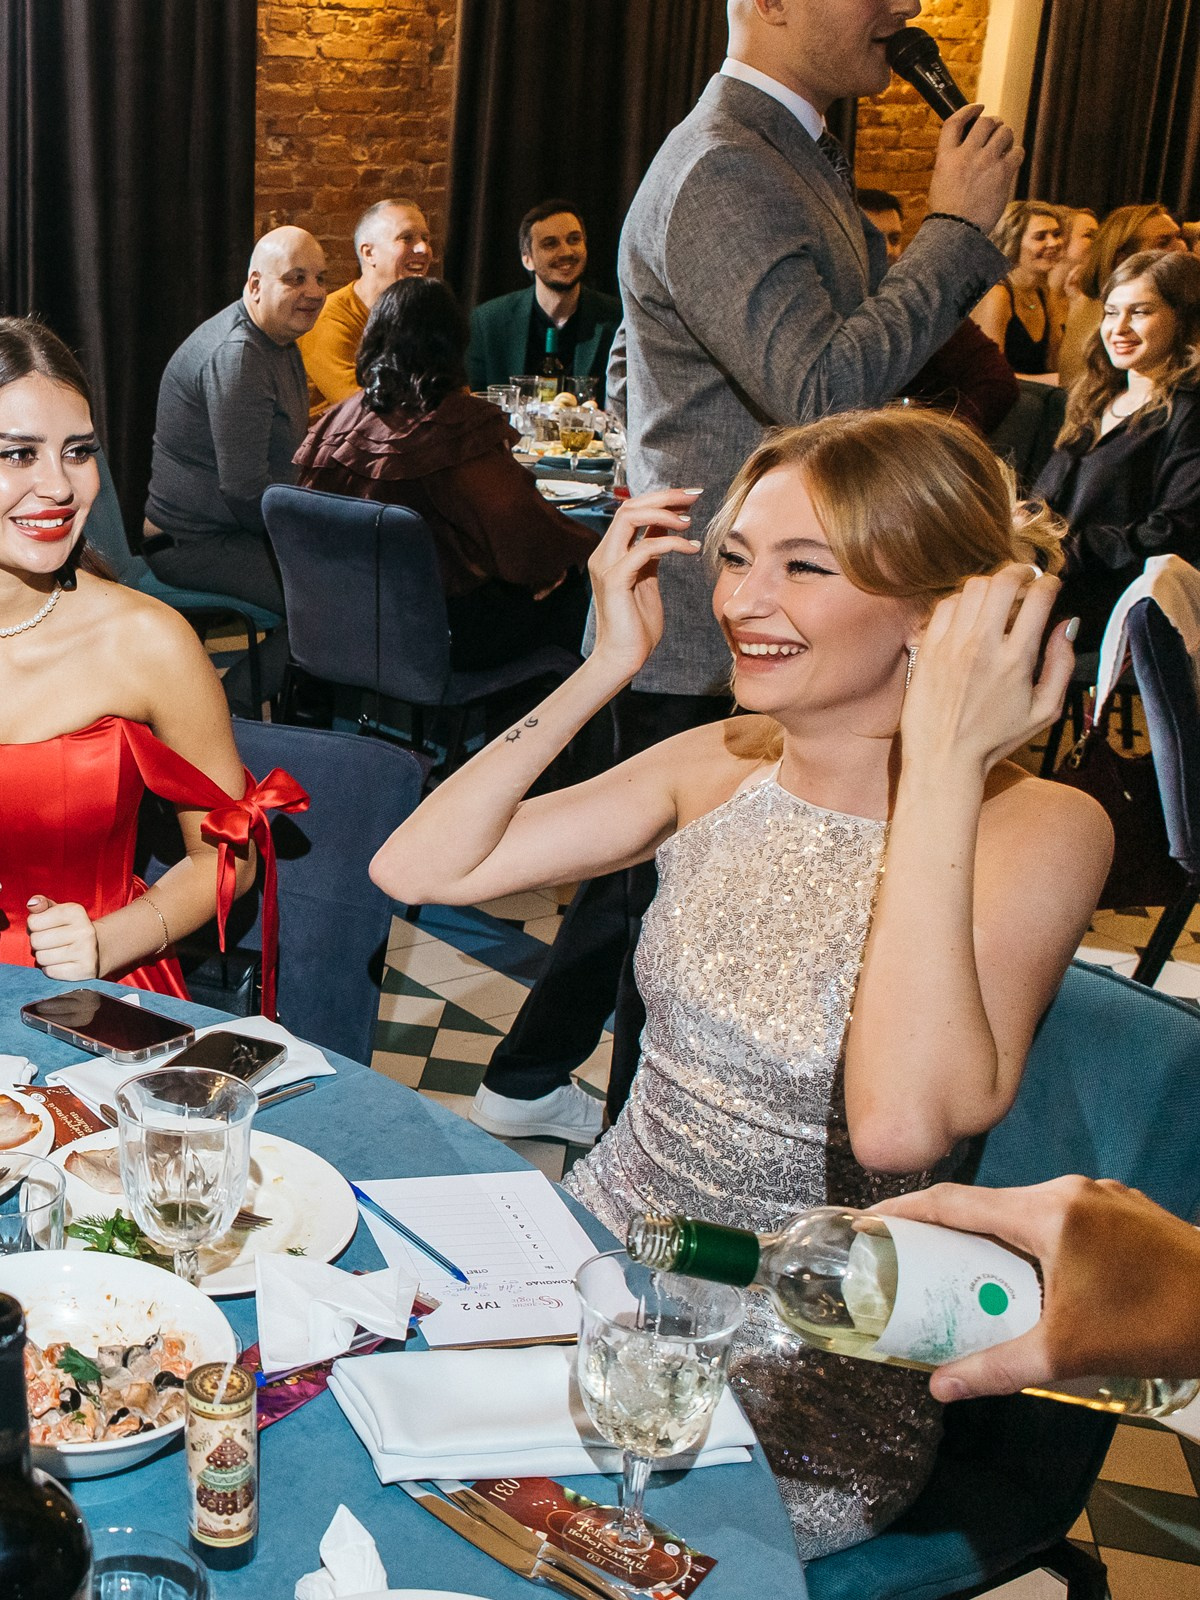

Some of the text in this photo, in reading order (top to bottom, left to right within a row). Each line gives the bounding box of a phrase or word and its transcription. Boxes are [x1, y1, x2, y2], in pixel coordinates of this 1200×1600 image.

[460, 1301, 501, 1311] ТУР 2
[488, 1479, 521, 1502] 031
[586, 1552, 606, 1566] 031
